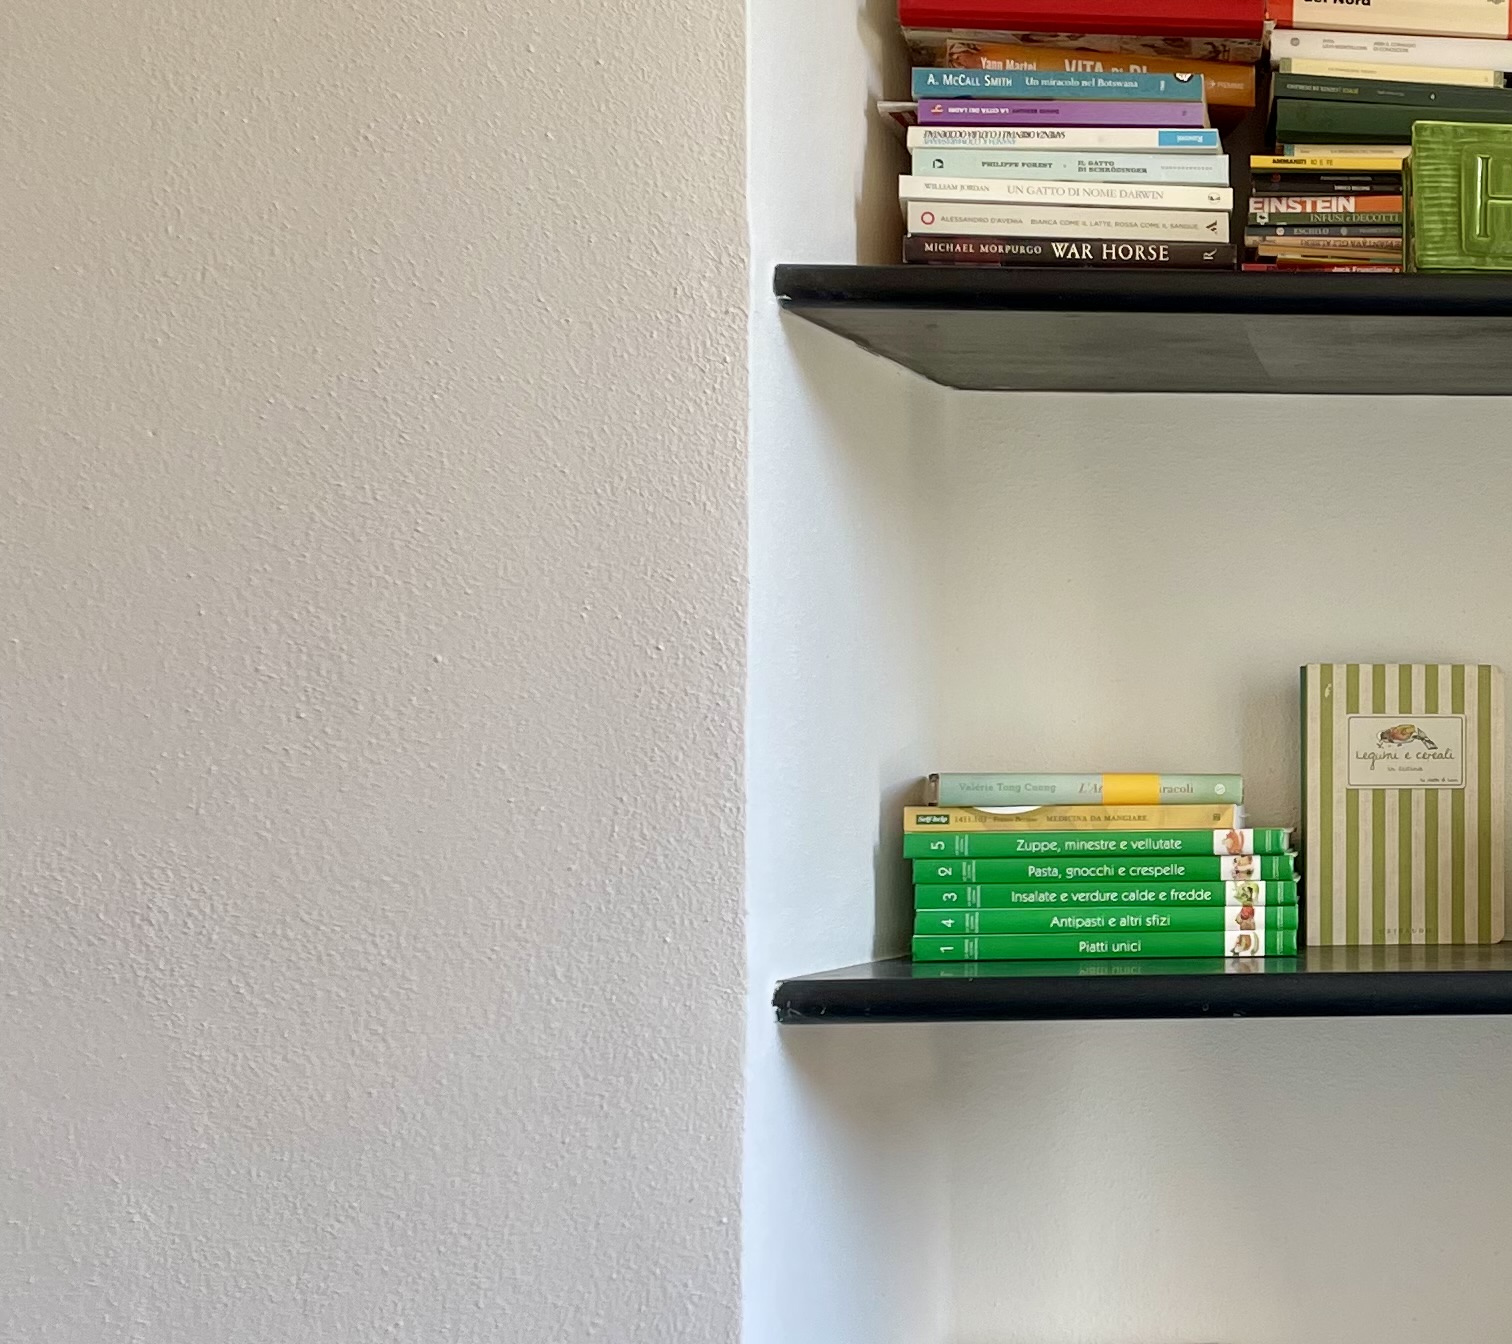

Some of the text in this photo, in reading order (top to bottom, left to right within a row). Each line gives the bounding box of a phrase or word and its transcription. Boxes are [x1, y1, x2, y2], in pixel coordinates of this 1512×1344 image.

[980, 57, 1003, 70] Yann
[1025, 76, 1138, 88] Un miracolo nel Botswana
[1021, 161, 1053, 169] FOREST
[1088, 166, 1148, 174] SCHRÖDINGER
[924, 183, 958, 191] WILLIAM
[1007, 185, 1164, 200] UN GATTO DI NOME DARWIN
[1250, 196, 1355, 213] EINSTEIN
[940, 216, 1023, 225] ALESSANDRO D'AVENIA
[1310, 213, 1344, 223] INFUSI
[1351, 213, 1399, 223] DECOTTI
[924, 242, 1042, 255] MICHAEL MORPURGO
[1051, 242, 1170, 262] WAR HORSE
[1355, 747, 1455, 771] Legumi e cereali
[996, 782, 1021, 793] Tong
[1103, 814, 1147, 822] MANGIARE
[930, 841, 945, 851] 5
[1016, 836, 1182, 853] Zuppe, minestre e vellutate
[937, 866, 952, 877] 2
[1028, 863, 1185, 879] Pasta, gnocchi e crespelle
[942, 892, 958, 902] 3
[1011, 888, 1212, 903] Insalate e verdure calde e fredde
[940, 918, 955, 928] 4
[1050, 914, 1171, 929] Antipasti e altri sfizi
[1079, 939, 1142, 953] Piatti unici
